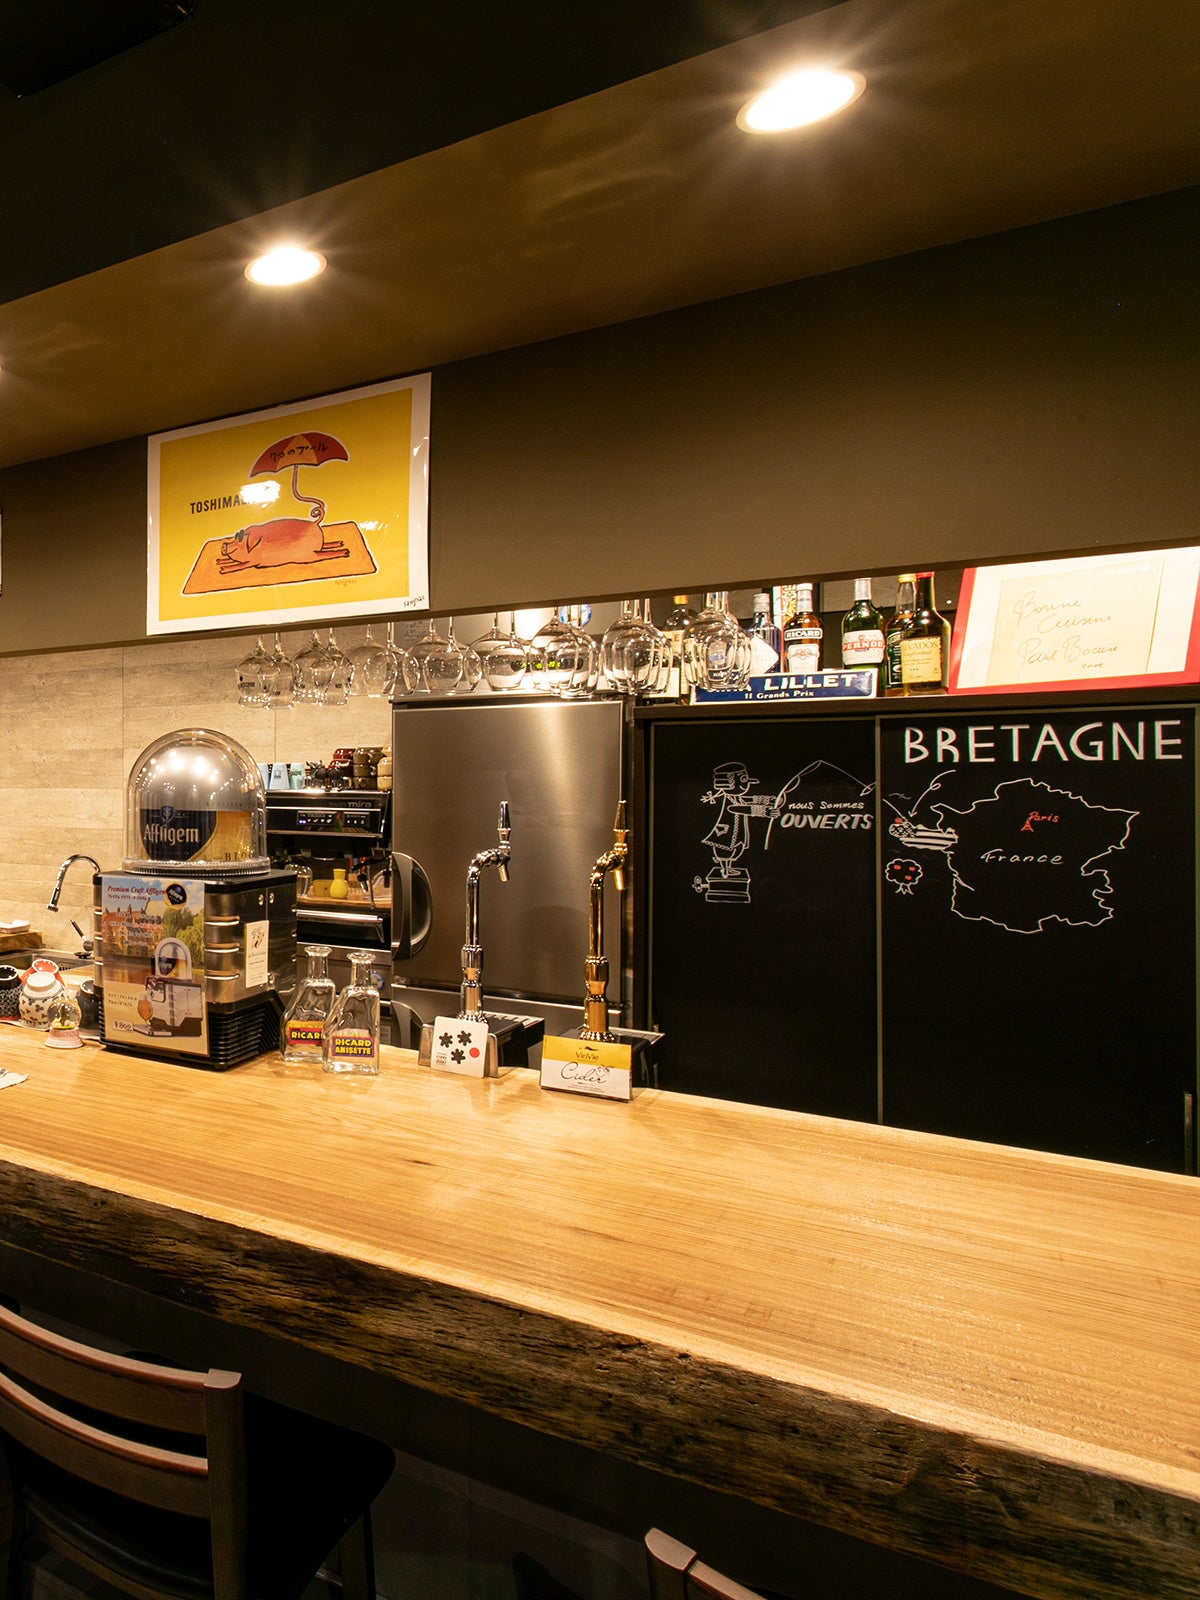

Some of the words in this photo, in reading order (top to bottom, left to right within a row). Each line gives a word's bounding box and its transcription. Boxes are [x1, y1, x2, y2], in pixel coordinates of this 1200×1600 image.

[190, 494, 253, 514] TOSHIMA
[786, 630, 820, 639] RICARD
[764, 674, 858, 691] LILLET
[756, 691, 790, 699] Grands
[904, 720, 1183, 764] BRETAGNE
[788, 801, 815, 810] nous
[780, 813, 874, 830] OUVERTS
[1027, 811, 1060, 823] Paris
[143, 824, 200, 846] Affligem
[980, 848, 1064, 865] France
[291, 1031, 323, 1040] RICAR
[334, 1039, 372, 1047] RICARD
[334, 1047, 371, 1055] ANISETTE
[561, 1062, 607, 1084] Cider
